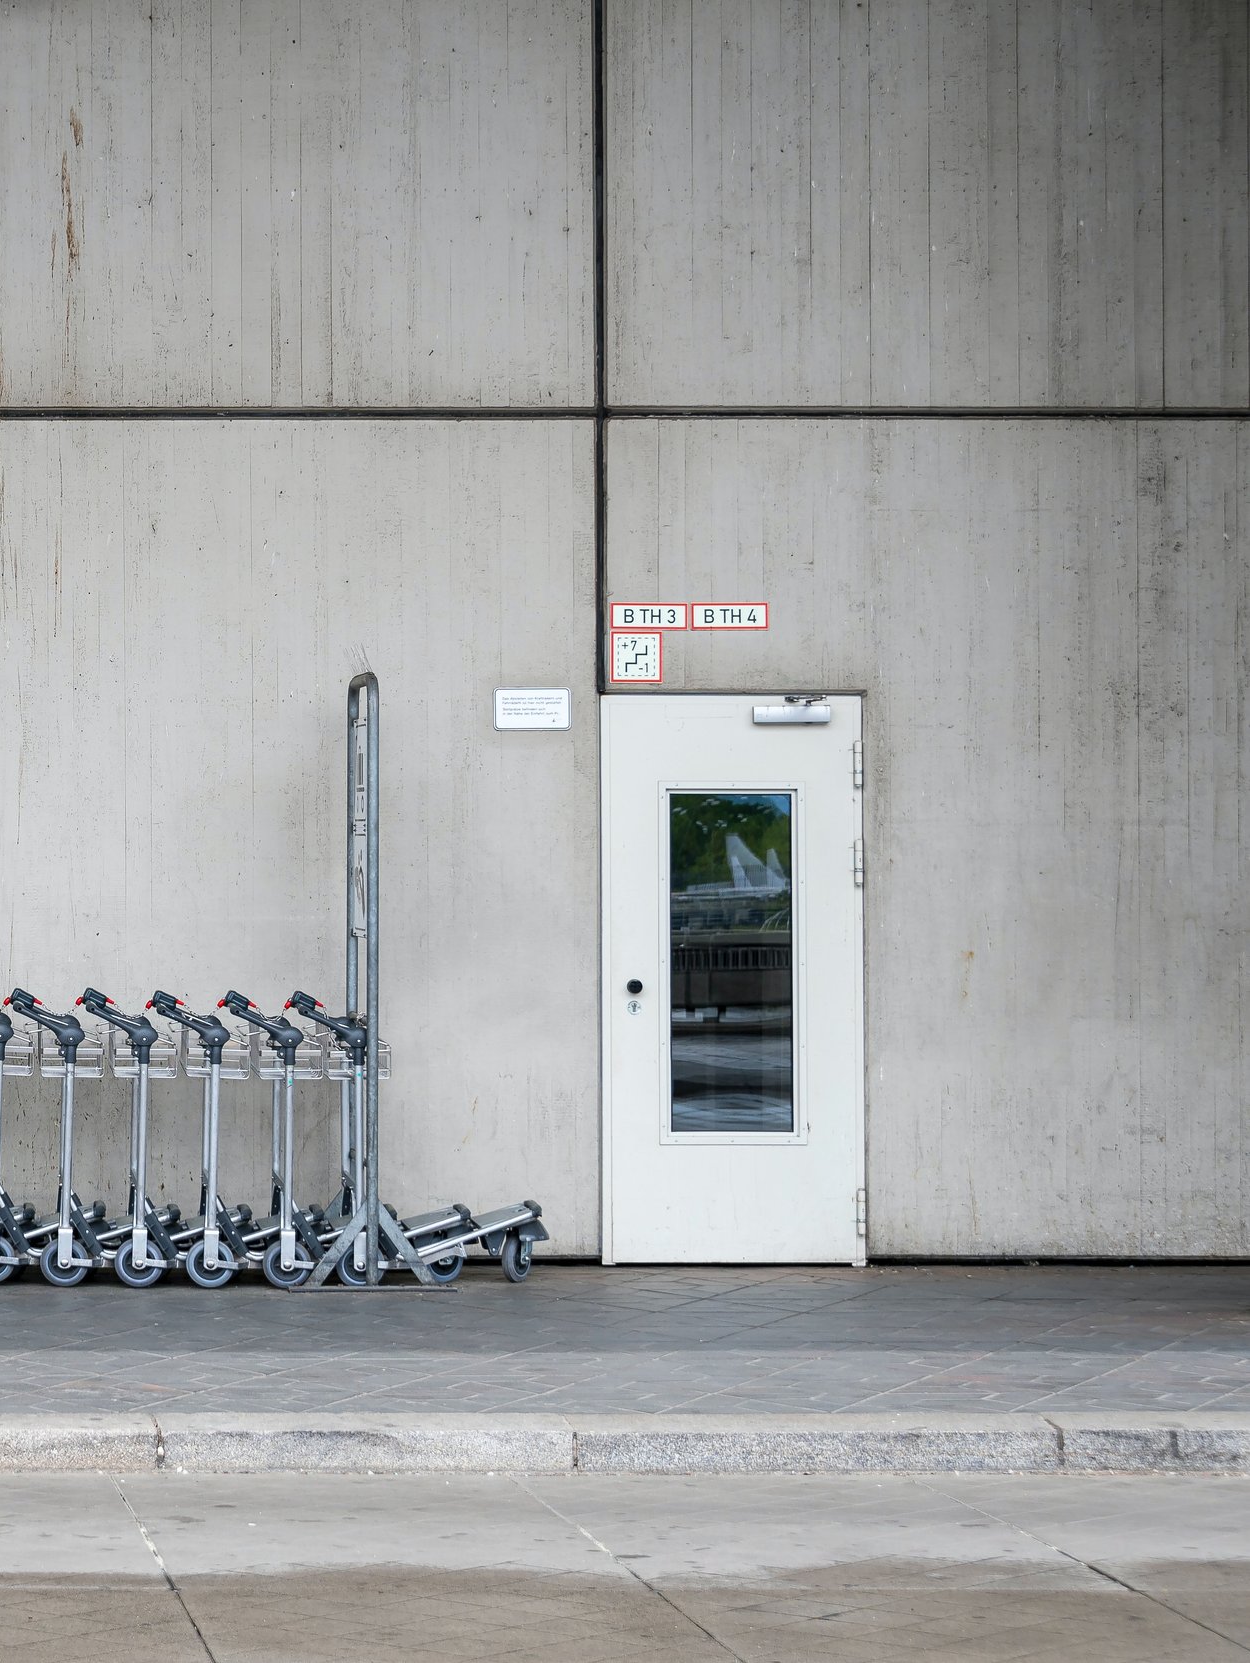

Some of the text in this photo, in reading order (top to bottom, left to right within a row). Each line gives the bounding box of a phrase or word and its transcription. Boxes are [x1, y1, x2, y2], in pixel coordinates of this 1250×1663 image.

[623, 608, 676, 624] B TH 3
[704, 608, 757, 624] B TH 4
[621, 640, 637, 651] +7
[639, 662, 649, 673] -1
